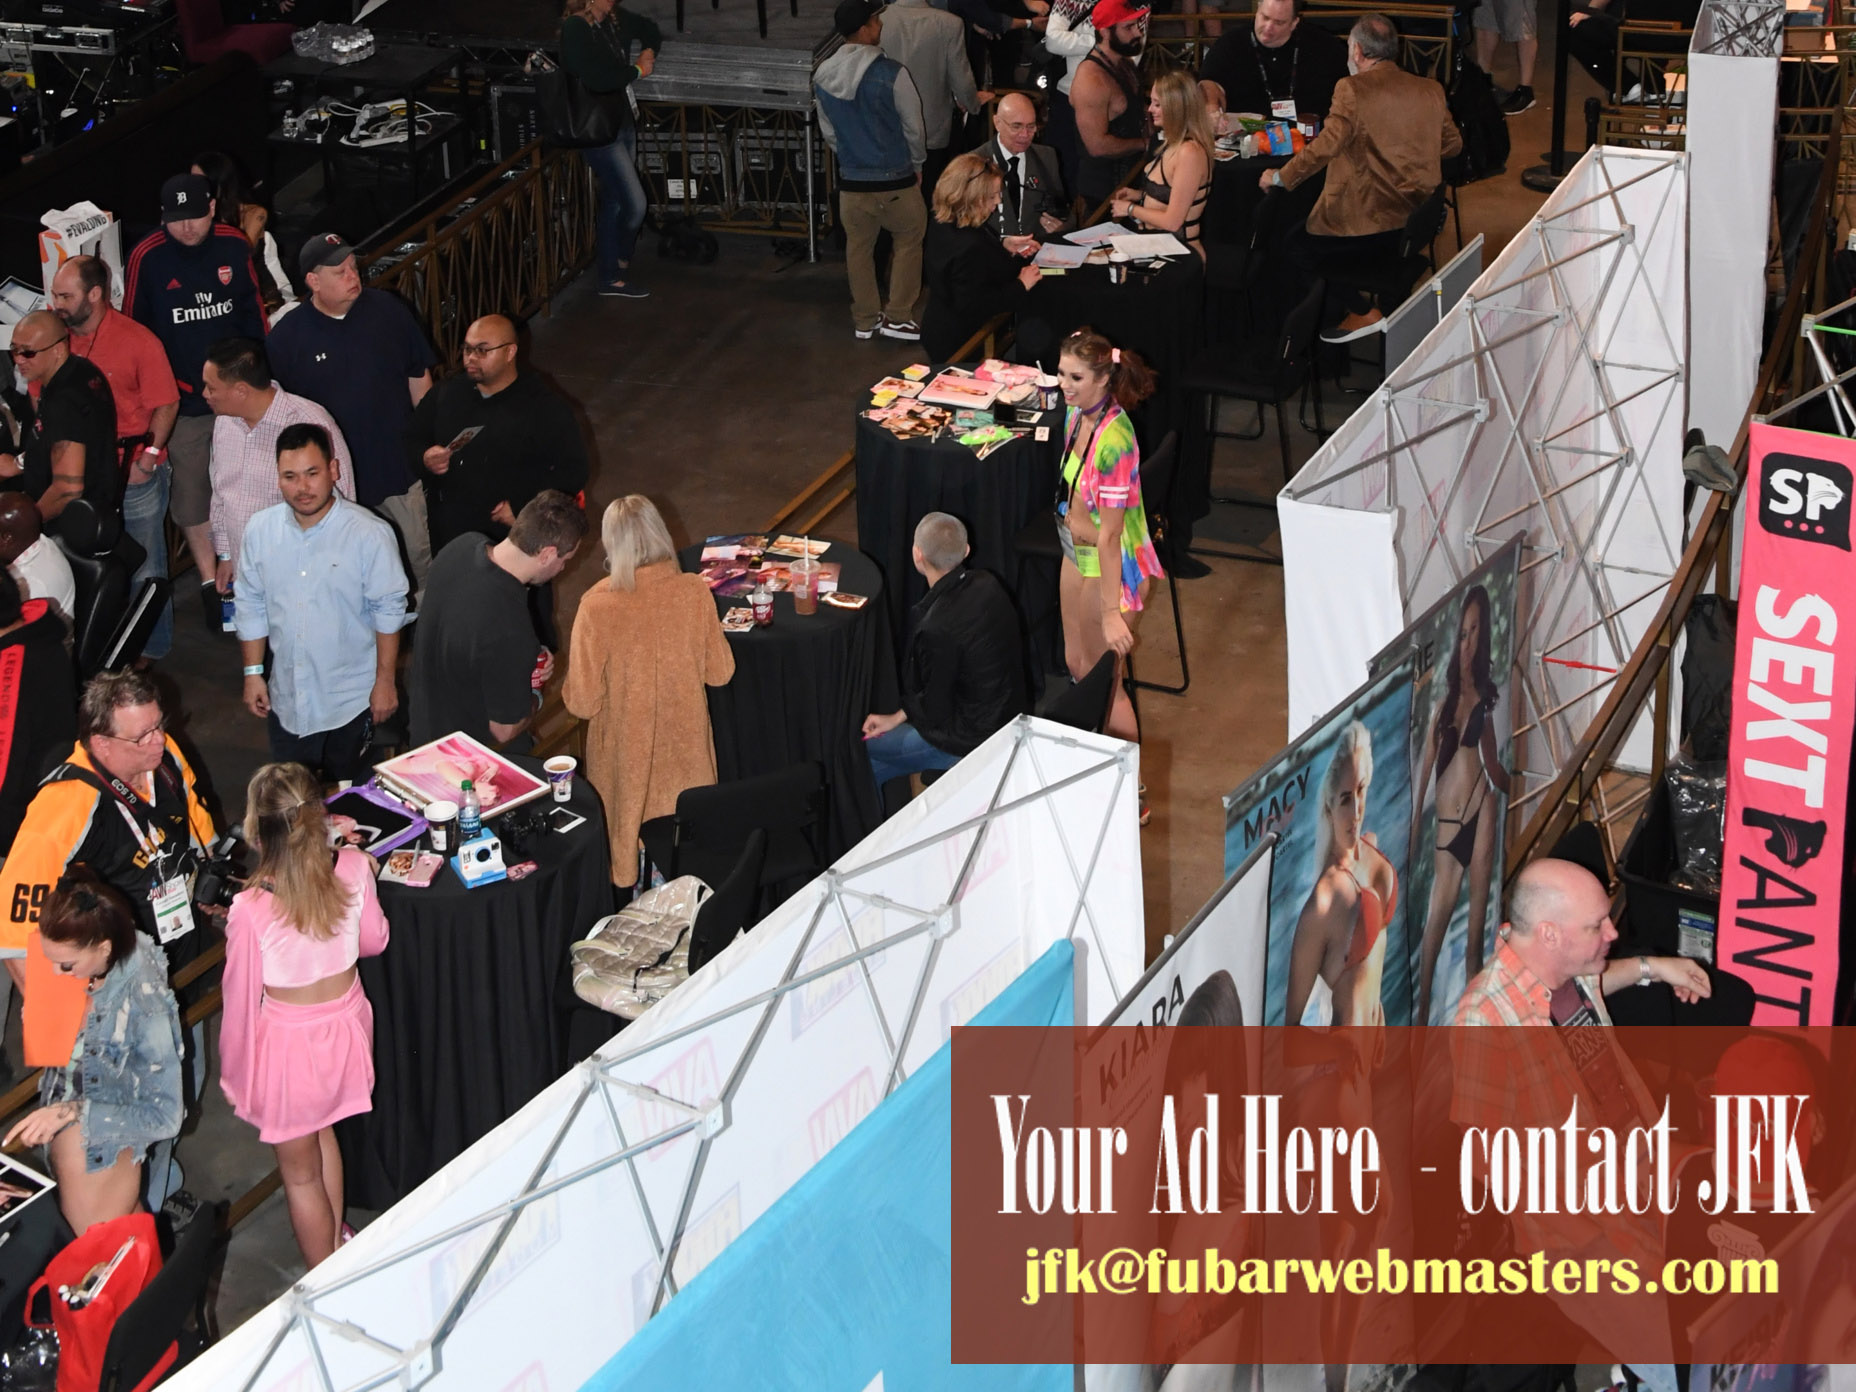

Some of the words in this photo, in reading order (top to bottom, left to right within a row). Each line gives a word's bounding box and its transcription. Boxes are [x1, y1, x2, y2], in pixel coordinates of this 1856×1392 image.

[172, 298, 234, 324] Emirates
[195, 291, 213, 305] Fly
[1743, 583, 1838, 809] SEXT
[111, 778, 130, 797] EOS
[1243, 765, 1311, 851] MACY
[10, 883, 51, 923] 69
[1100, 973, 1185, 1105] KIARA
